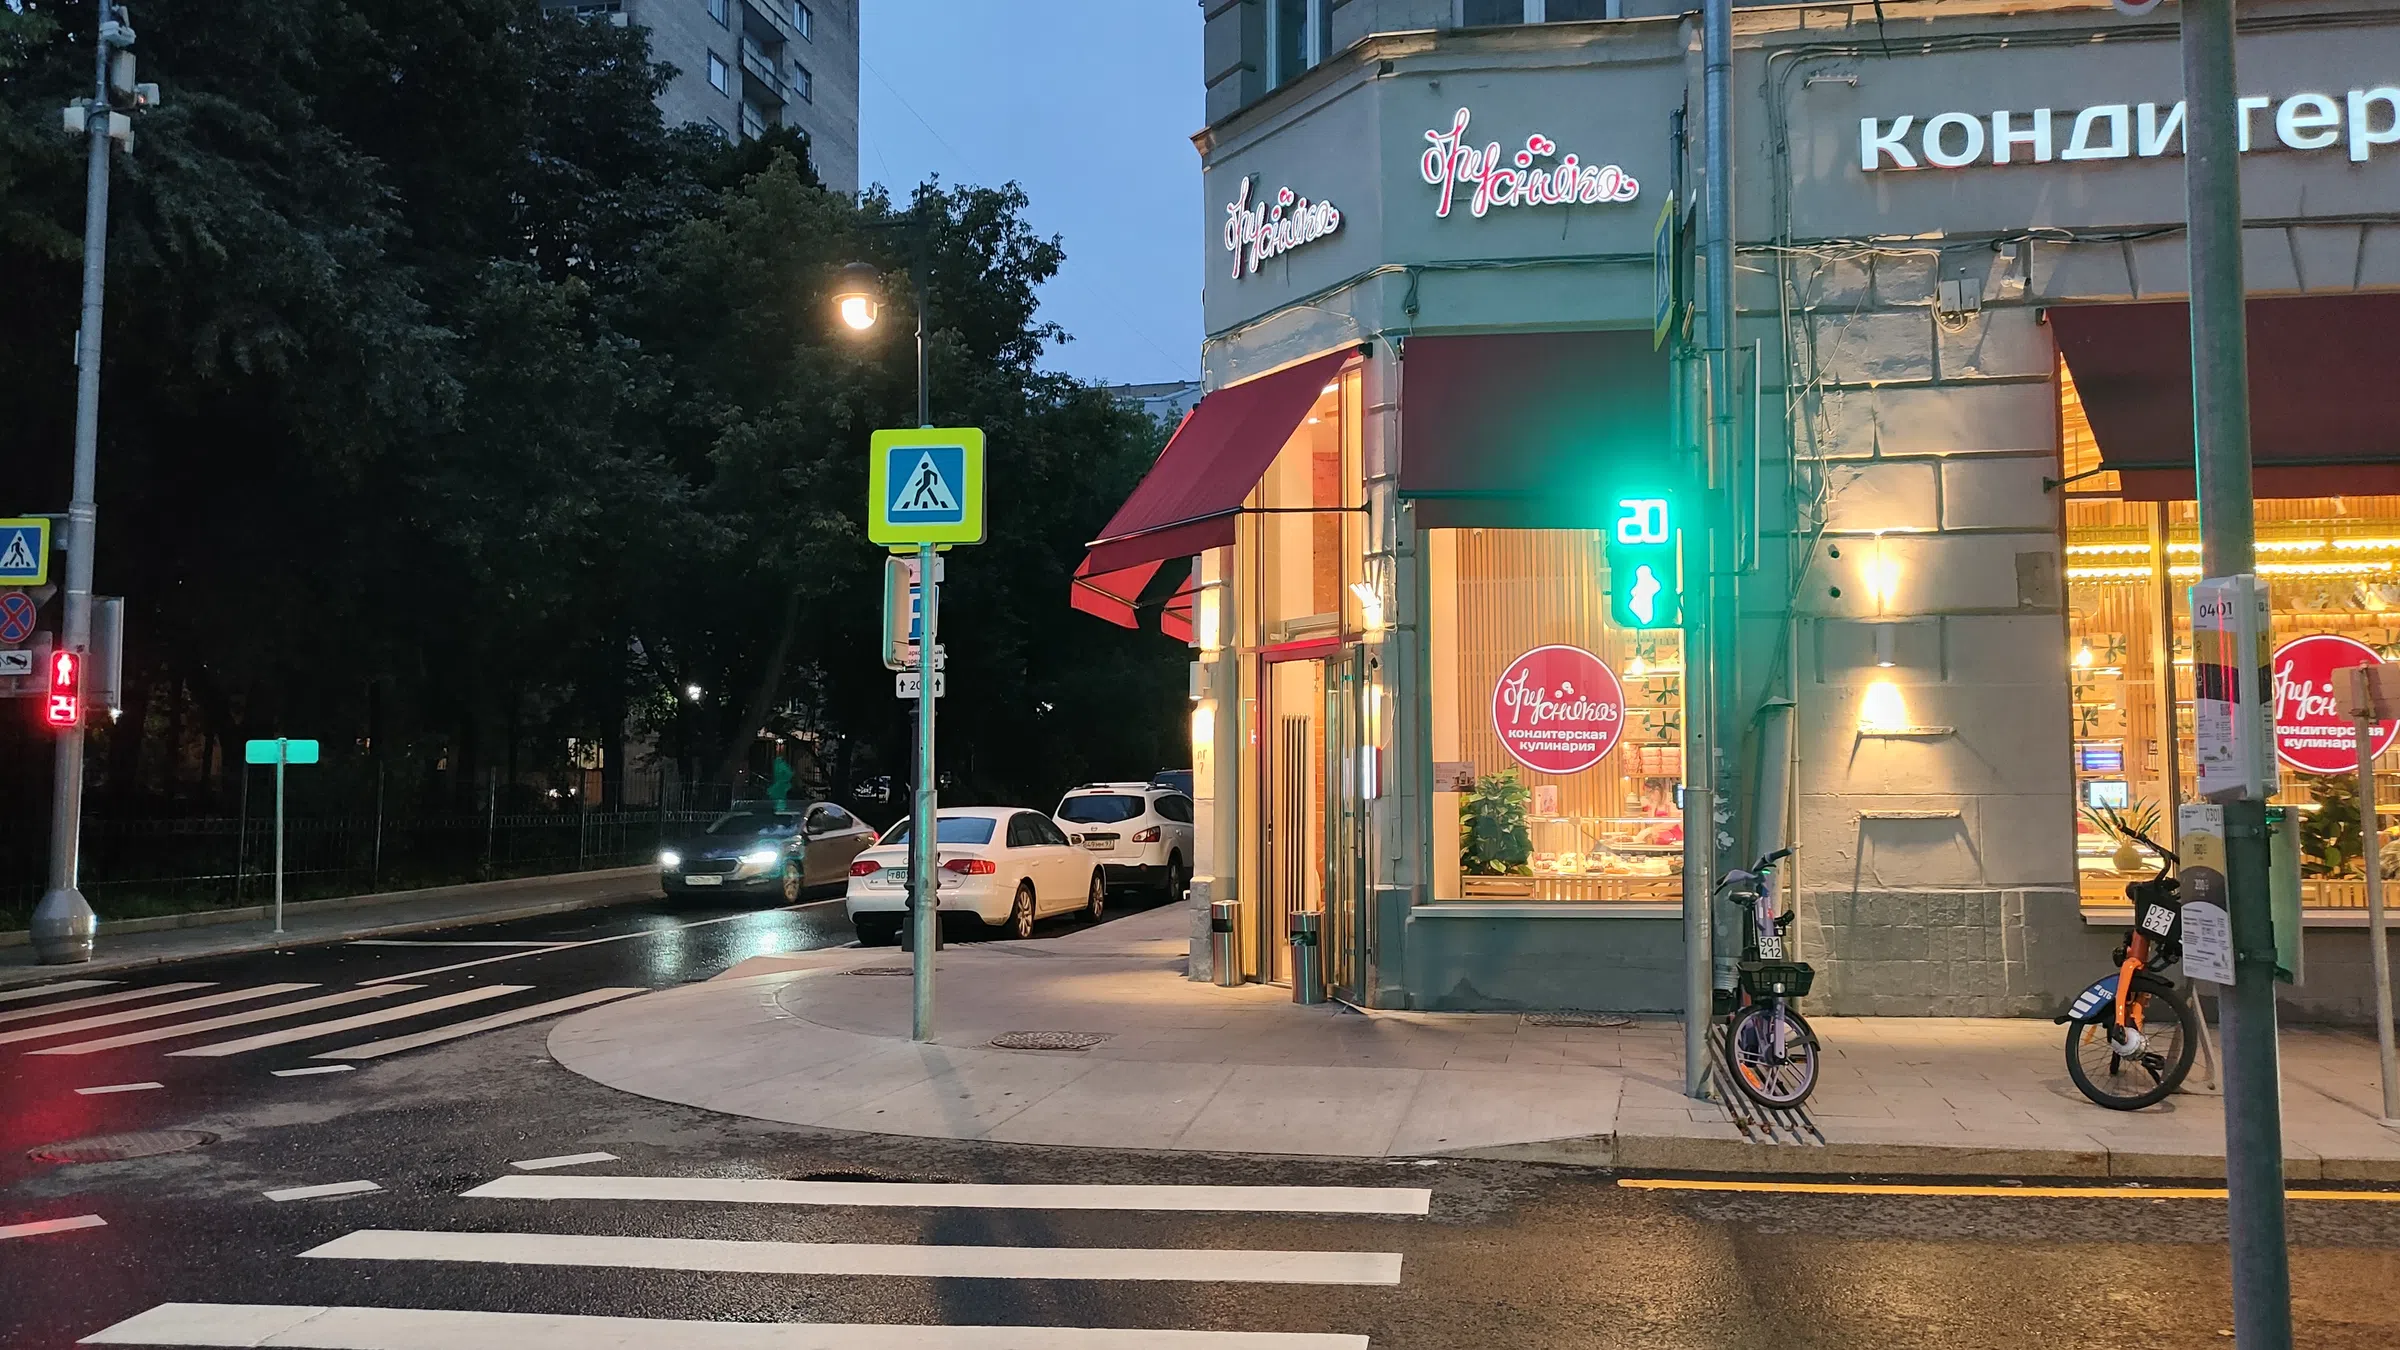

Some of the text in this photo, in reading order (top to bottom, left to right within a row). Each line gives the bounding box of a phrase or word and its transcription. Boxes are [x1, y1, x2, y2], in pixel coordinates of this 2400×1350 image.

[1618, 499, 1668, 544] 20
[2200, 602, 2232, 618] 0401
[1508, 729, 1607, 741] кондитерская
[1520, 741, 1596, 753] кулинария
[2150, 906, 2173, 922] 025
[2145, 918, 2168, 934] 821
[1760, 938, 1780, 947] 501
[1761, 948, 1781, 957] 412
